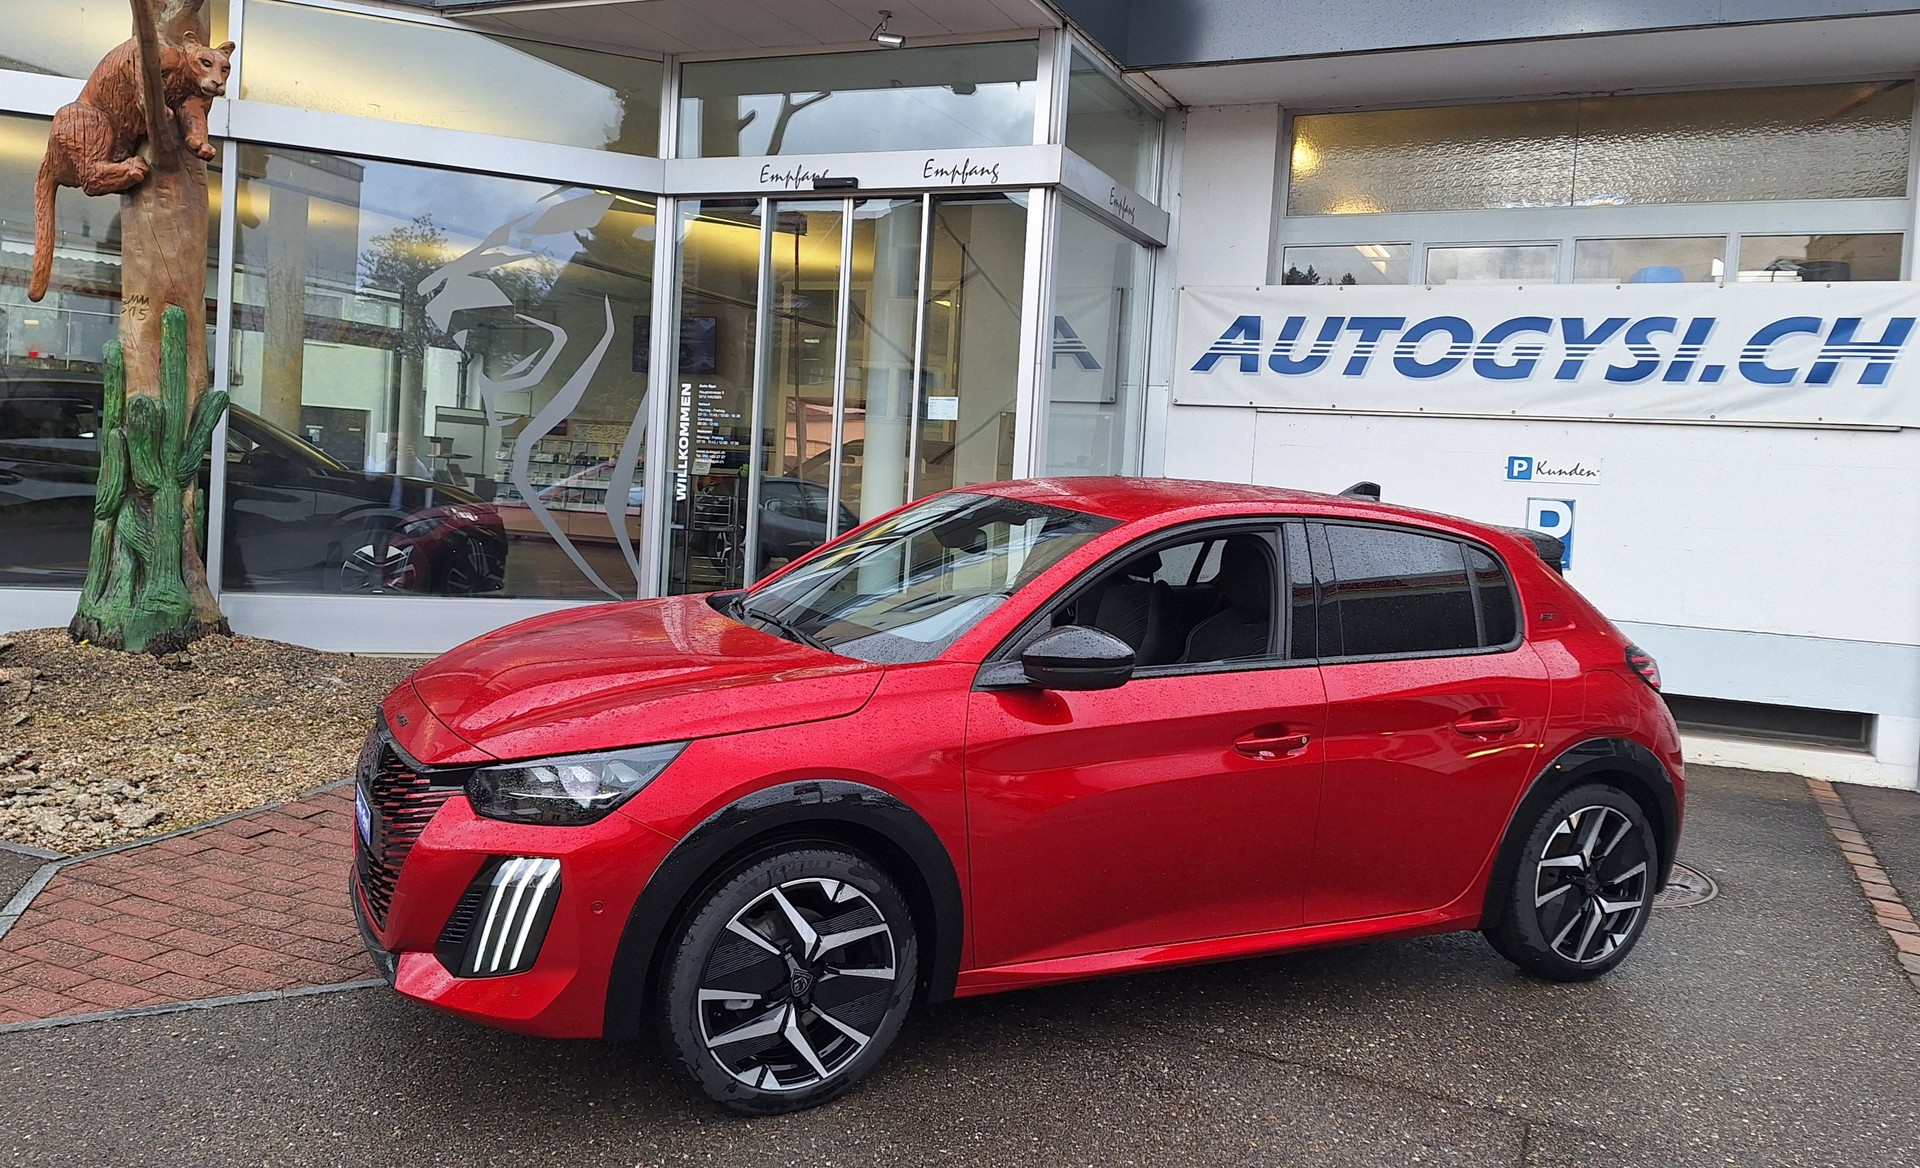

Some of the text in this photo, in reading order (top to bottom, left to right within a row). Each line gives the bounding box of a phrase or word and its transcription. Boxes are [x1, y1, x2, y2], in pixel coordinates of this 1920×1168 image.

[923, 158, 1000, 184] Empfang
[1189, 315, 1918, 386] AUTOGYSI.CH
[676, 383, 692, 502] WILLKOMMEN
[1536, 461, 1597, 477] Kunden
